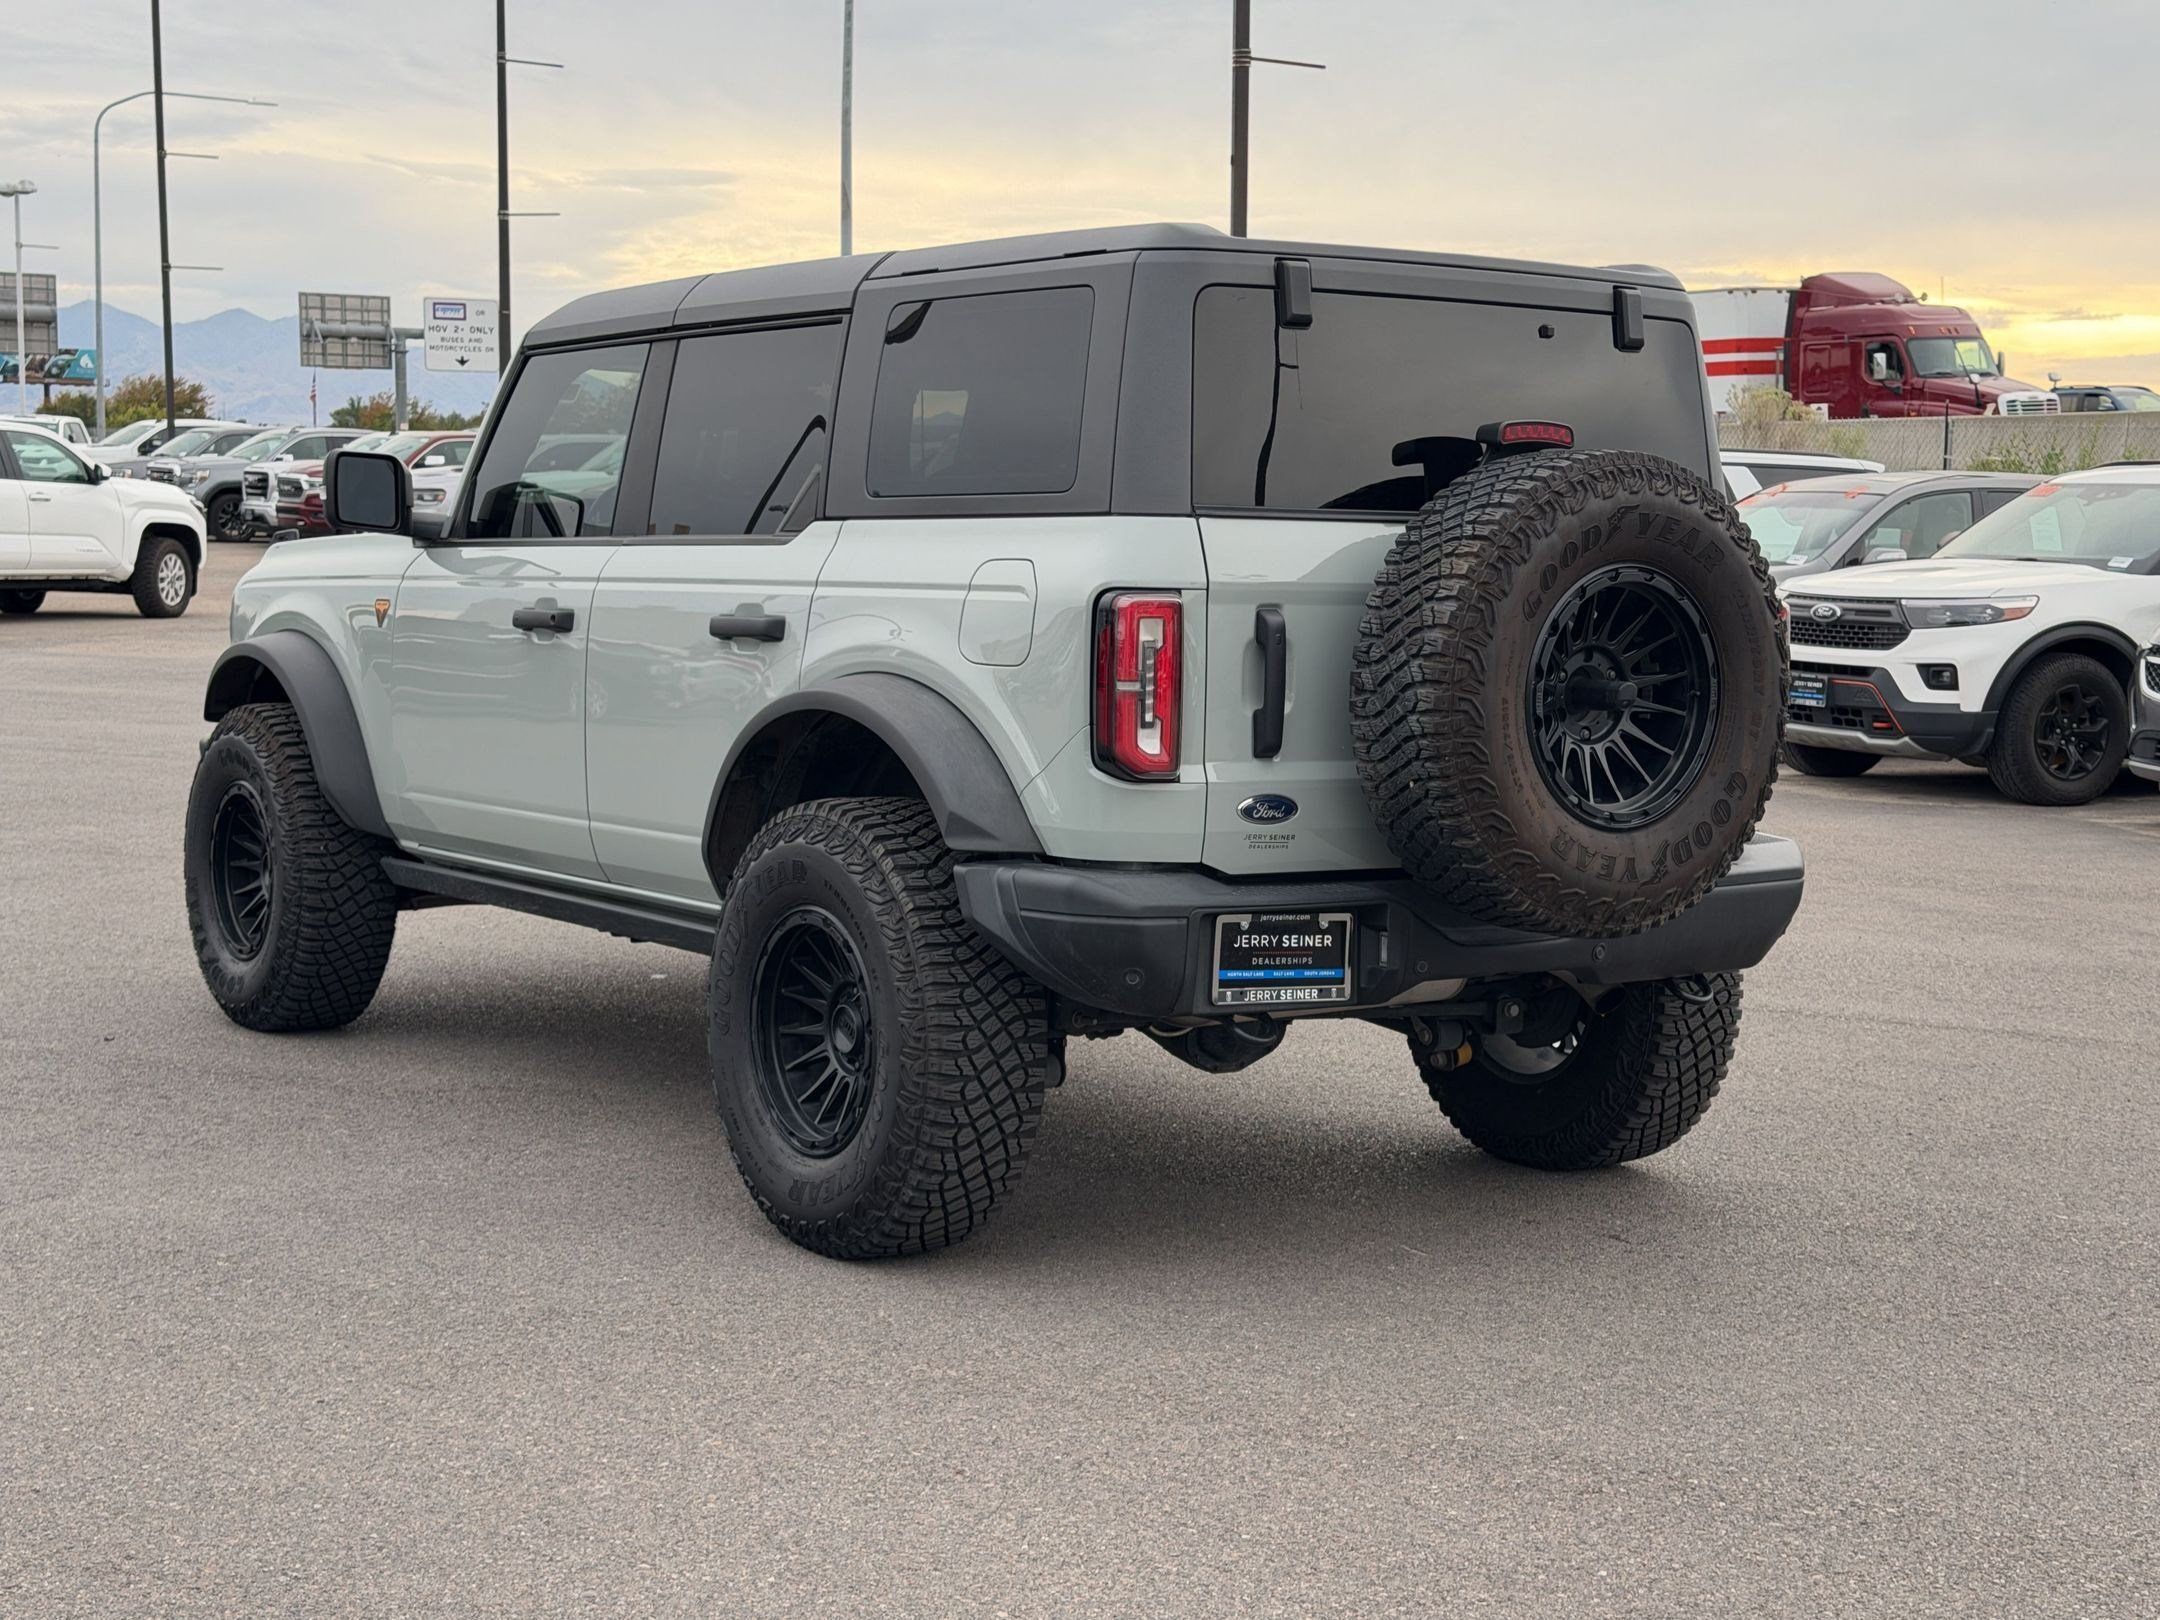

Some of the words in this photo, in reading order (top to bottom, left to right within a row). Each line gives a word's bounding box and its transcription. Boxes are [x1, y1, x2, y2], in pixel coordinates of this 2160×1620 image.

[428, 325, 448, 333] HOV
[469, 326, 495, 335] ONLY
[429, 344, 482, 352] MOTORCYCLES
[1816, 607, 1833, 616] Ford
[1252, 801, 1285, 818] Ford
[1243, 833, 1268, 841] JERRY
[1269, 833, 1296, 841] SEINER
[1260, 914, 1311, 922] jerryseiner.com
[1233, 934, 1279, 947] JERRY
[1282, 934, 1333, 947] SEINER
[1252, 957, 1313, 965] DEALERSHIPS
[1243, 990, 1278, 1002] JERRY
[1280, 988, 1318, 1000] SEINER
